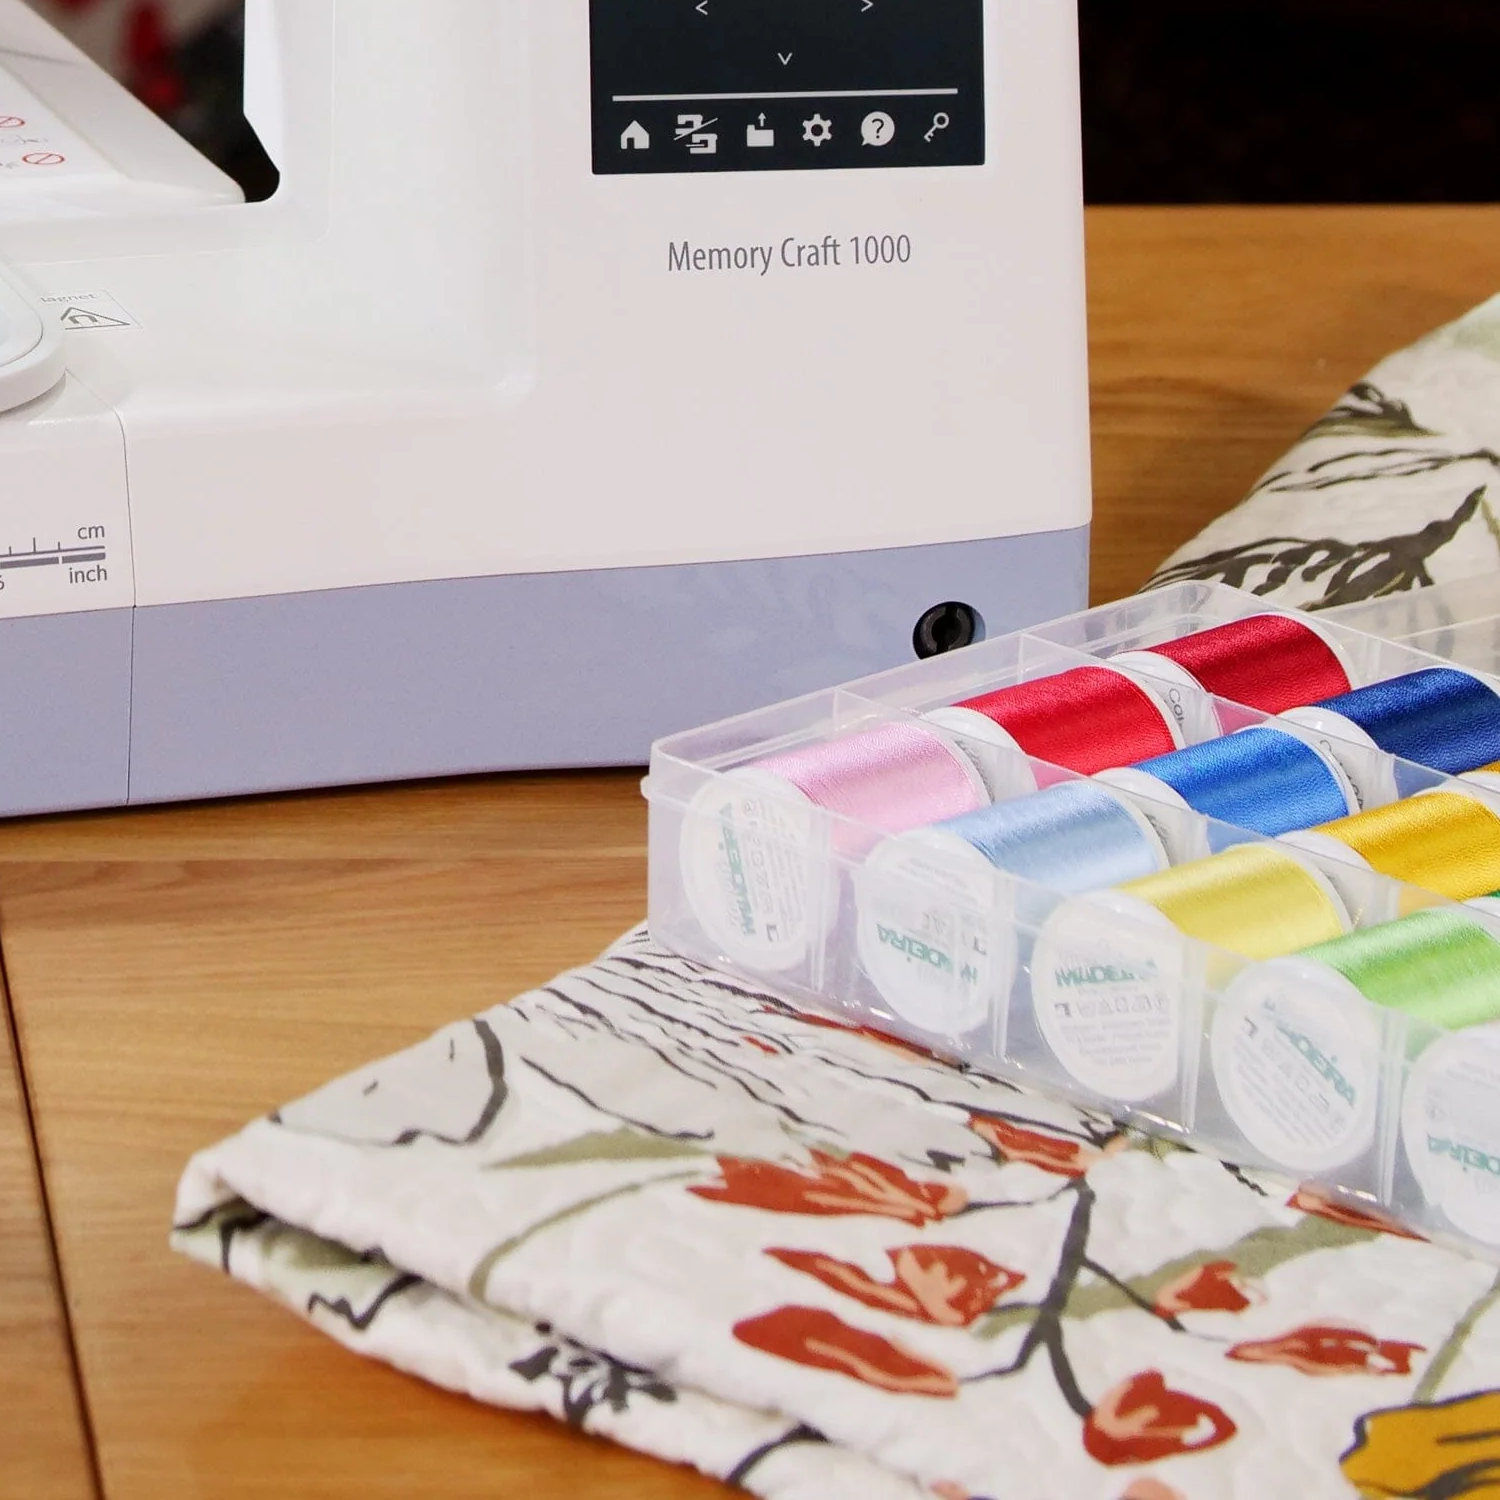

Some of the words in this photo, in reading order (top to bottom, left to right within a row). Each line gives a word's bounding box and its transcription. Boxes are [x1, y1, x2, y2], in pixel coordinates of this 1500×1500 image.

[668, 240, 773, 276] Memory
[780, 236, 841, 268] Craft
[849, 234, 912, 266] 1000
[40, 294, 98, 304] agnet
[77, 525, 106, 540] cm
[68, 565, 108, 584] inch
[877, 924, 979, 986] MDEIRA
